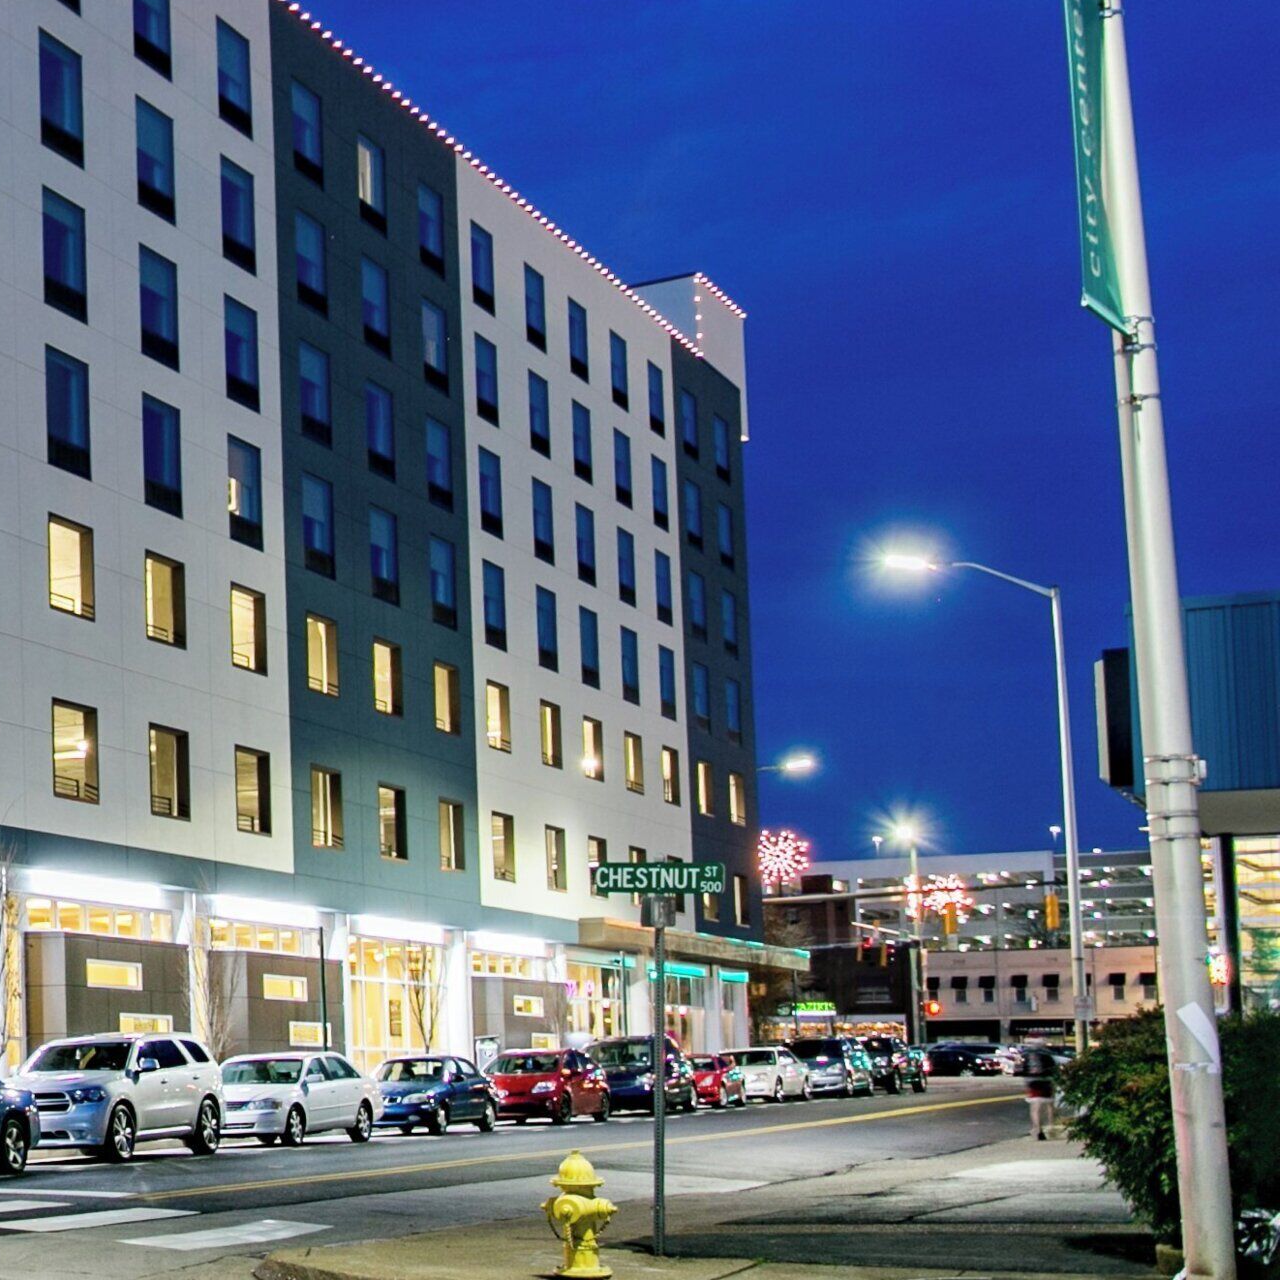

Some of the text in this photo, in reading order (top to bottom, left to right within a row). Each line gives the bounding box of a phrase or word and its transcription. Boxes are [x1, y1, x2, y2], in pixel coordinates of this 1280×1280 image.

[596, 866, 719, 889] CHESTNUT ST
[700, 881, 723, 893] 500
